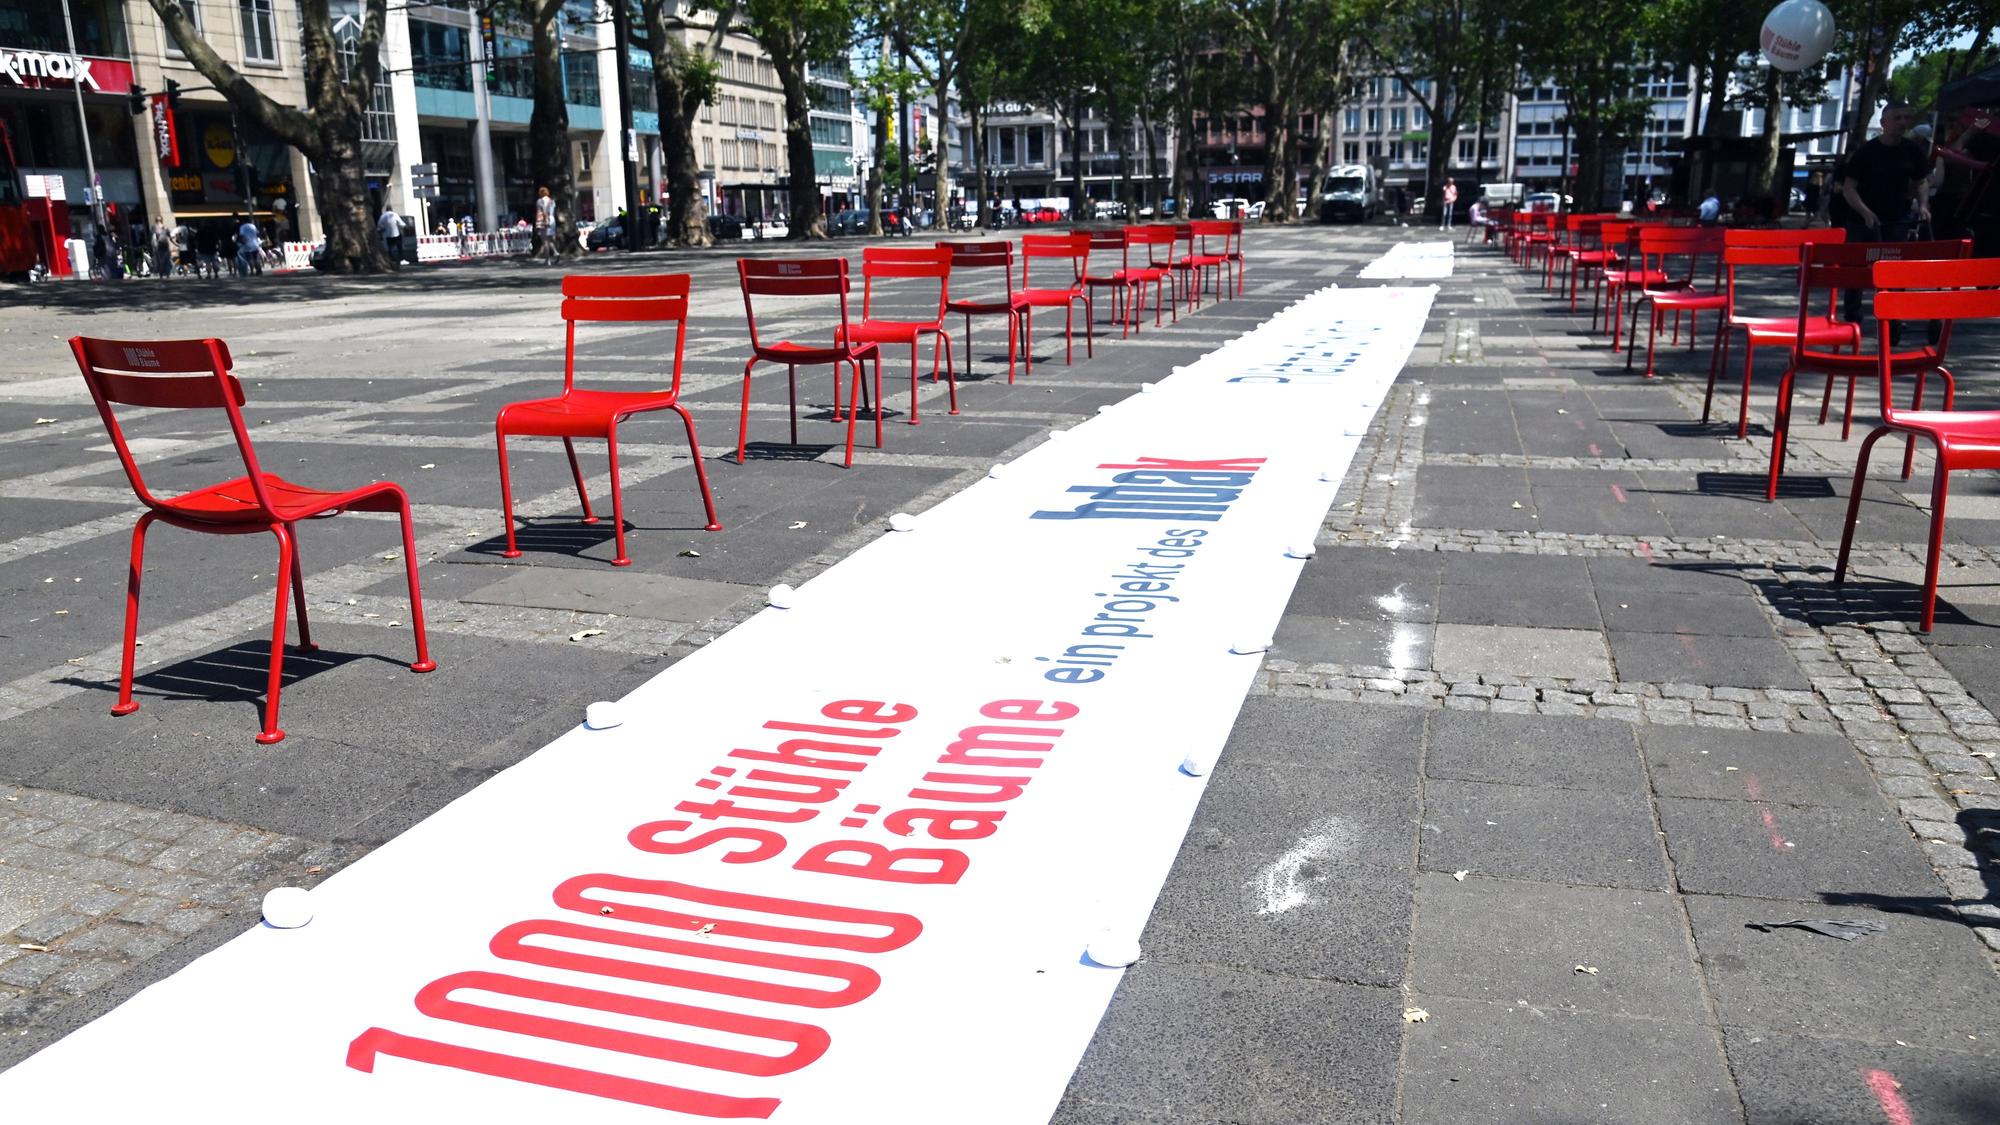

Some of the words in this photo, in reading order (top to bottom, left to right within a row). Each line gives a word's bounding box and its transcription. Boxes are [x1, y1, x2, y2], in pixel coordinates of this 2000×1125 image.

[1029, 456, 1268, 522] hdak
[1034, 644, 1126, 685] ein
[1081, 562, 1186, 639] projekt
[1136, 528, 1209, 559] des
[626, 699, 919, 865] Stühle
[792, 699, 1080, 885] Bäume
[345, 872, 924, 1120] 1000
